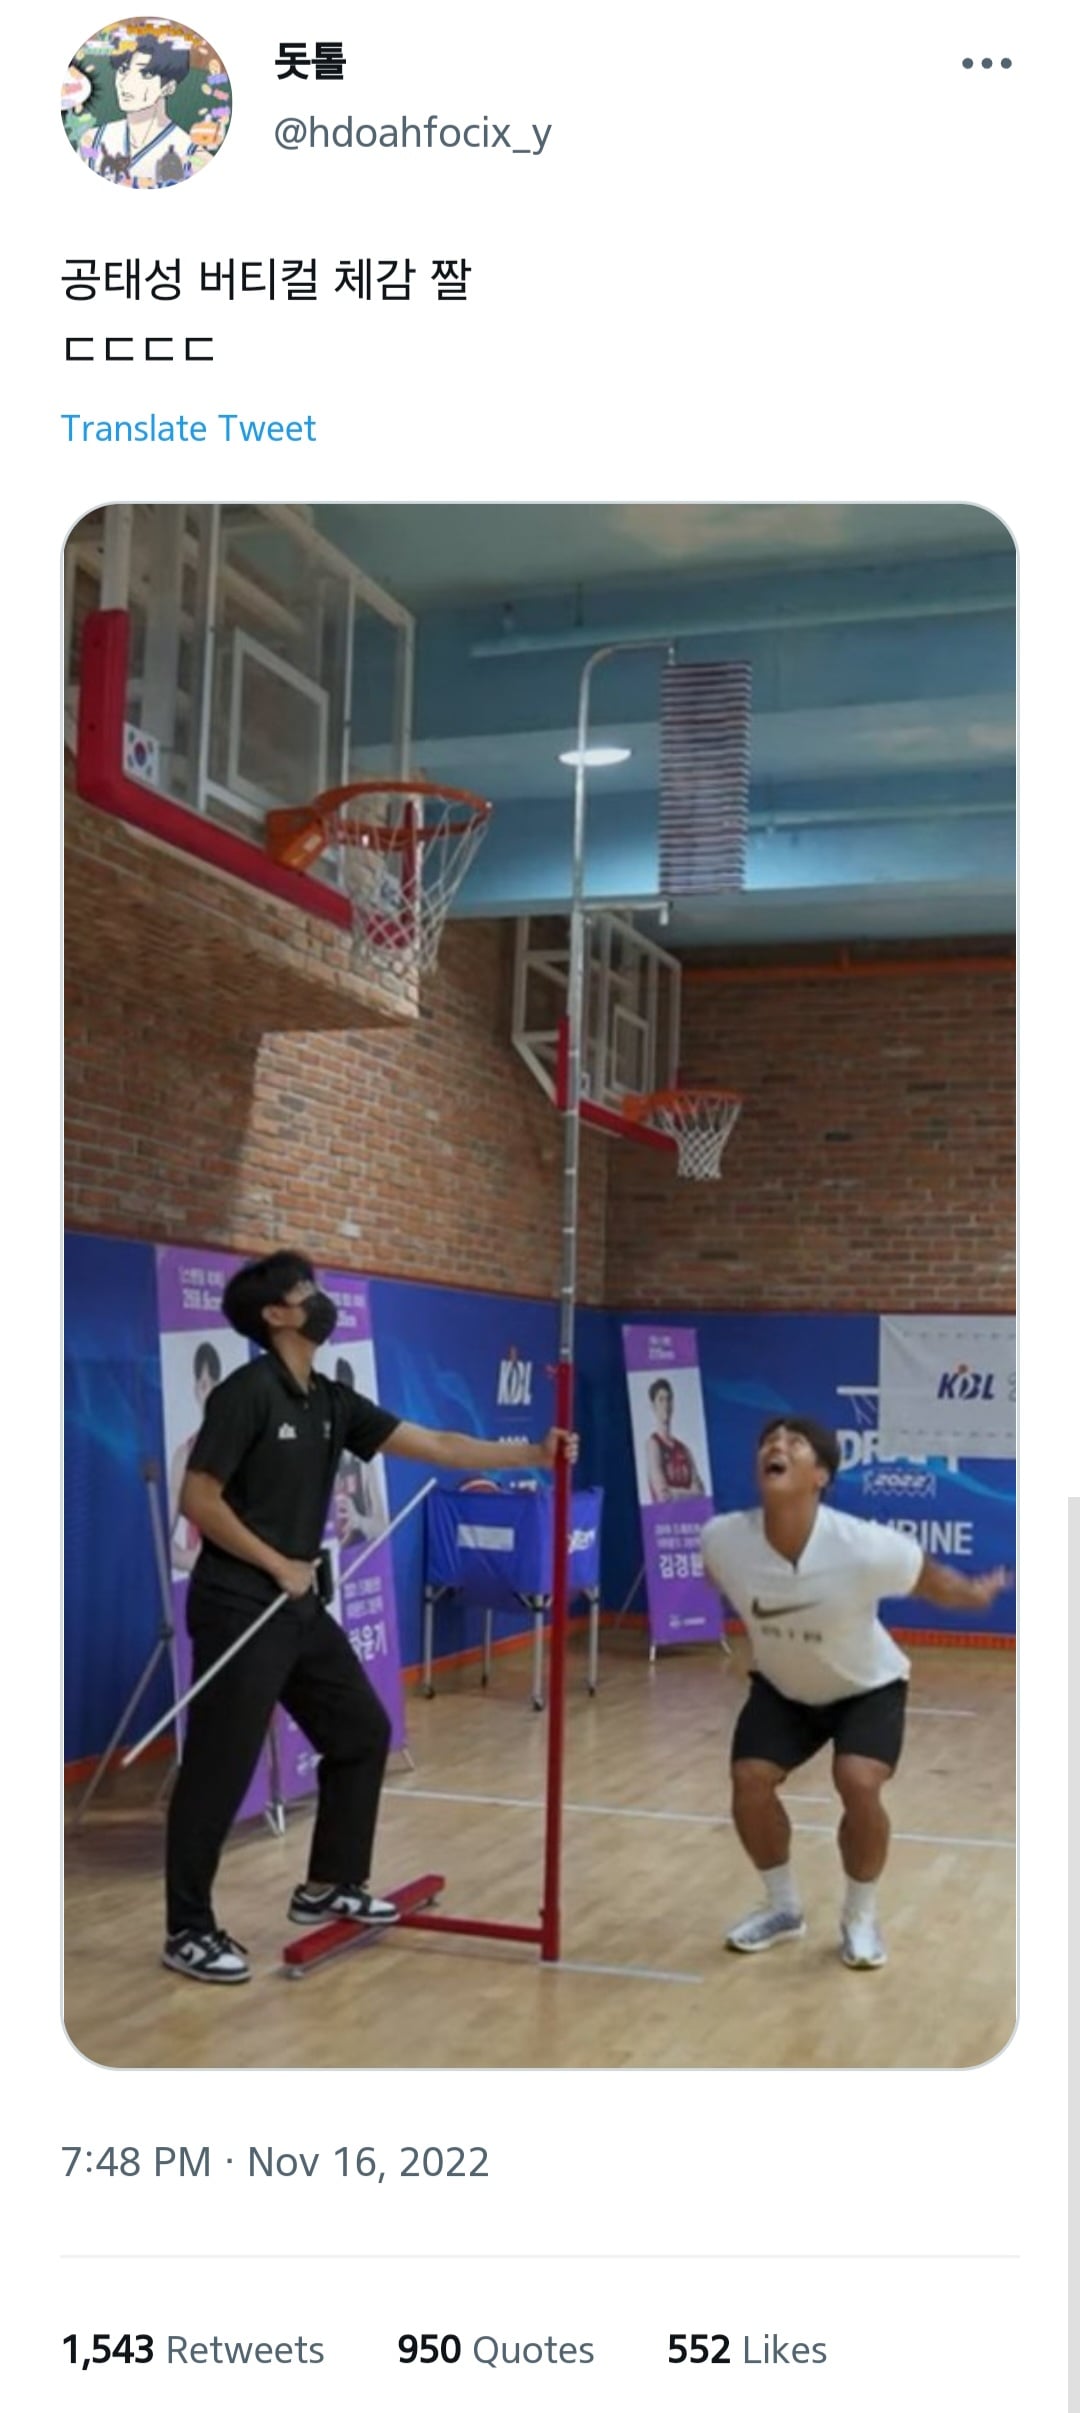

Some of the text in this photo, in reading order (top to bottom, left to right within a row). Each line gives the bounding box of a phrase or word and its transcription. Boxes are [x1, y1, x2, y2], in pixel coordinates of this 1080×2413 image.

[274, 41, 347, 81] 돗톨
[274, 114, 553, 156] @hdoahfocix_y
[61, 257, 472, 302] 공태성 버티컬 체감 짤
[65, 337, 214, 362] ㄷㄷㄷㄷ
[60, 413, 317, 442] Translate Tweet
[937, 1366, 995, 1400] KBL
[61, 2146, 489, 2184] 7:48 PM Nov 16, 2022
[63, 2333, 325, 2371] 1,543 Retweets
[398, 2333, 594, 2369] 950 Quotes
[668, 2333, 827, 2364] 552 Likes
